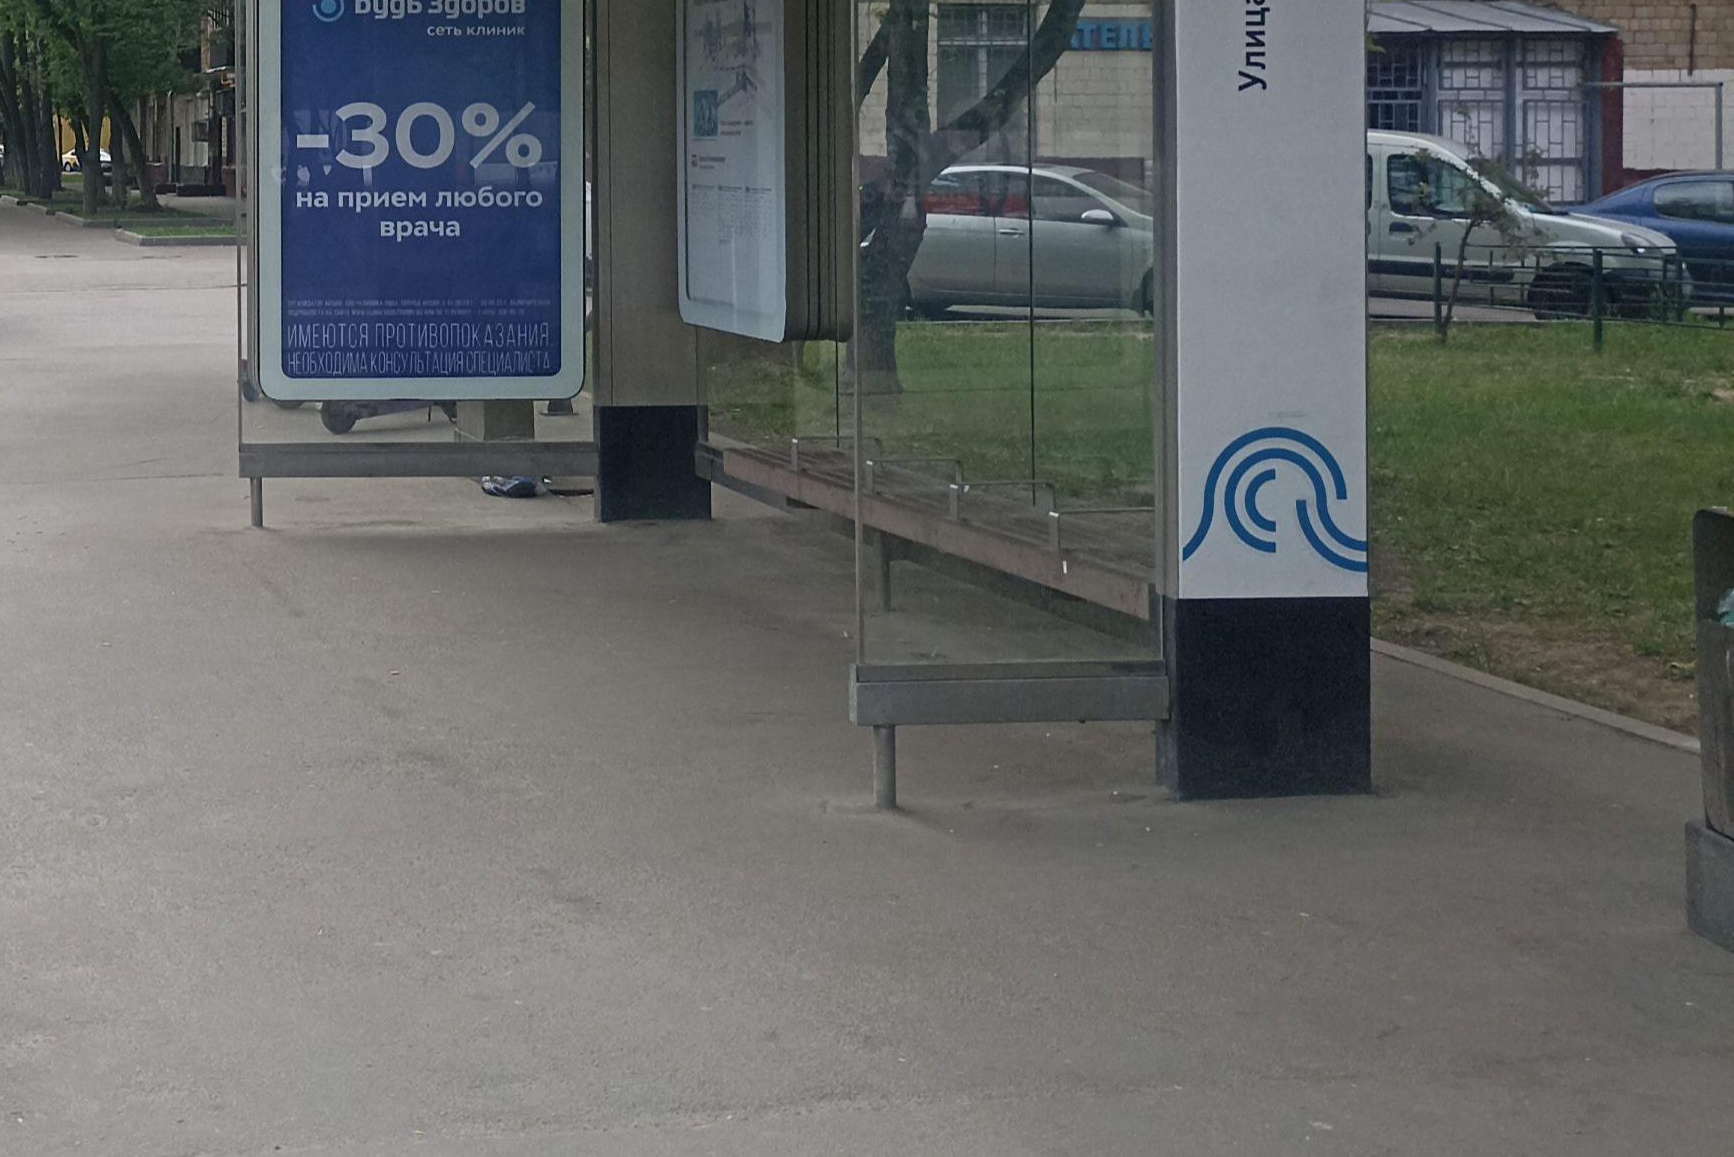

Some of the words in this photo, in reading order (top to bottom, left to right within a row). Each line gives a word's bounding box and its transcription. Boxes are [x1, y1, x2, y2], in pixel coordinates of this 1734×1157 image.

[426, 26, 462, 36] сеть
[466, 26, 525, 36] клиник
[296, 100, 543, 170] -30%
[296, 189, 329, 208] на
[338, 189, 428, 213] прием
[435, 187, 543, 208] любого
[380, 219, 461, 241] врача
[287, 322, 369, 348] ИМЕЮТСЯ
[287, 351, 368, 376] НЕОБХОДИМА
[370, 350, 464, 375] КОНСУЛЬТАЦИЯ
[465, 350, 550, 375] СПЕЦИАЛИСТА
